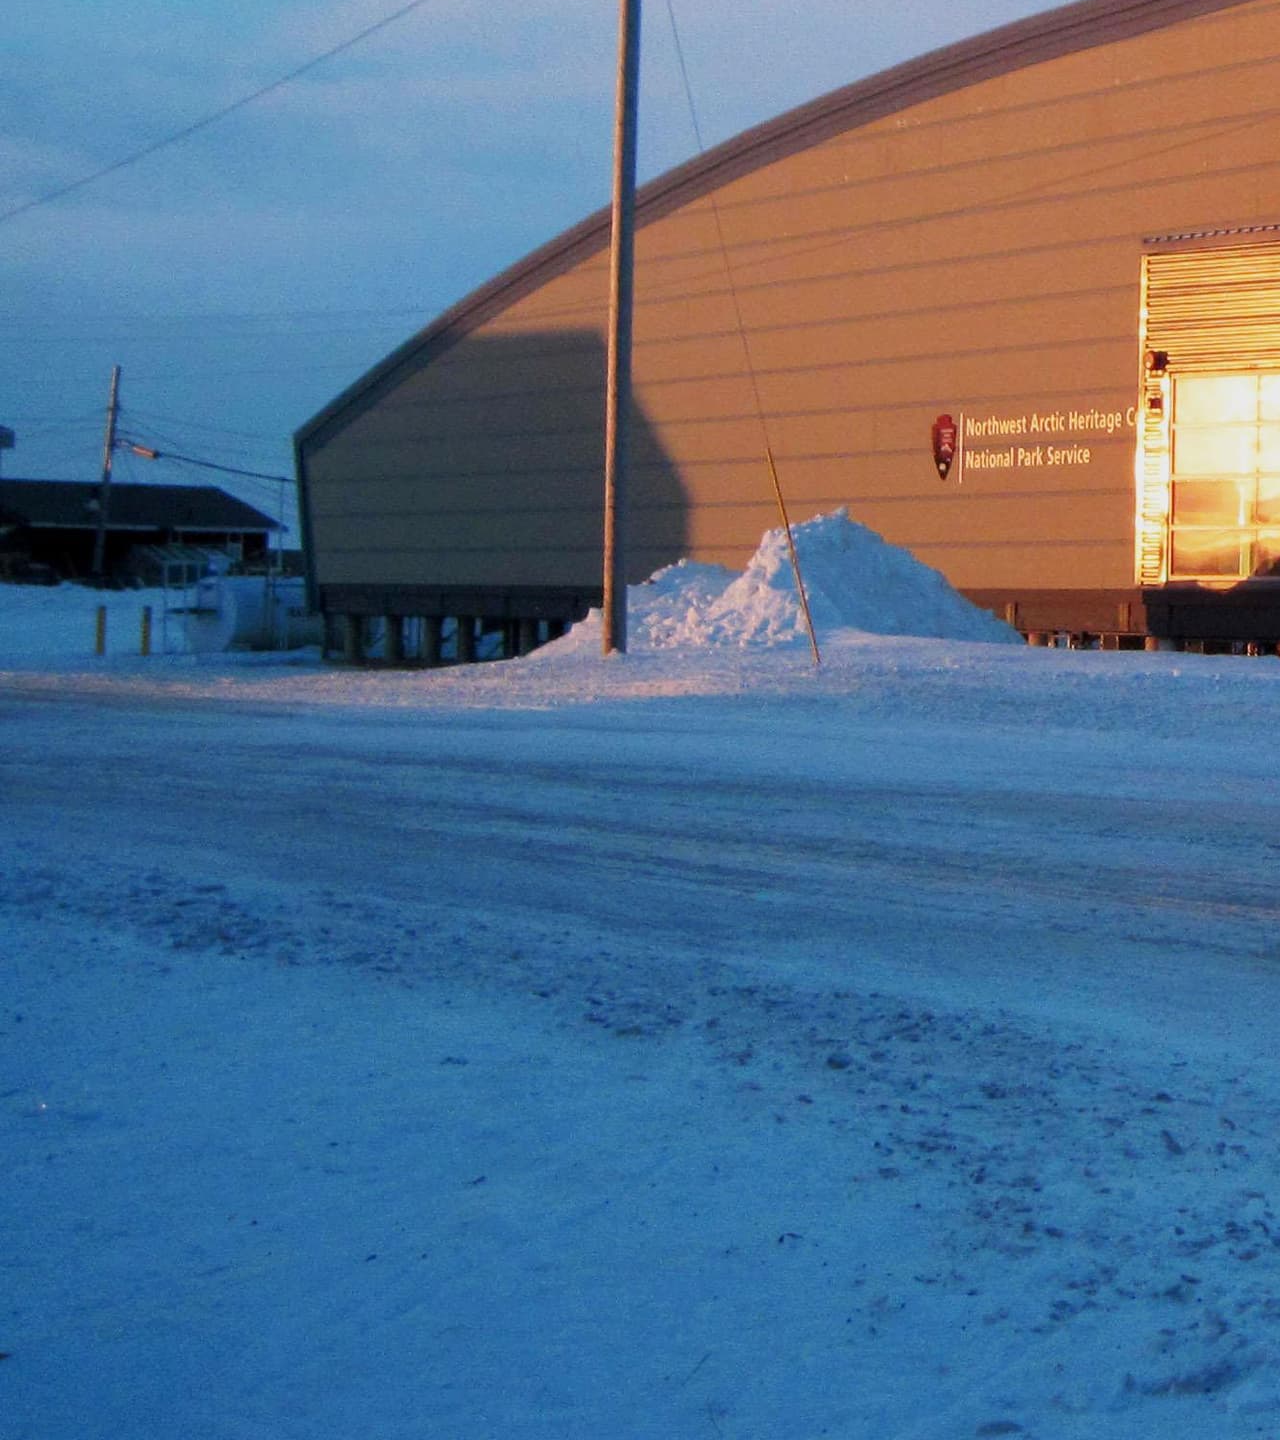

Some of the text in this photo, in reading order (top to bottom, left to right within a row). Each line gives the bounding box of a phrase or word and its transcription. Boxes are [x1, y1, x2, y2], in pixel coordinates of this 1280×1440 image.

[966, 415, 1027, 436] Northwest
[1030, 411, 1066, 433] Arctic
[1068, 409, 1122, 433] Heritage
[965, 444, 1090, 469] National Park Service
